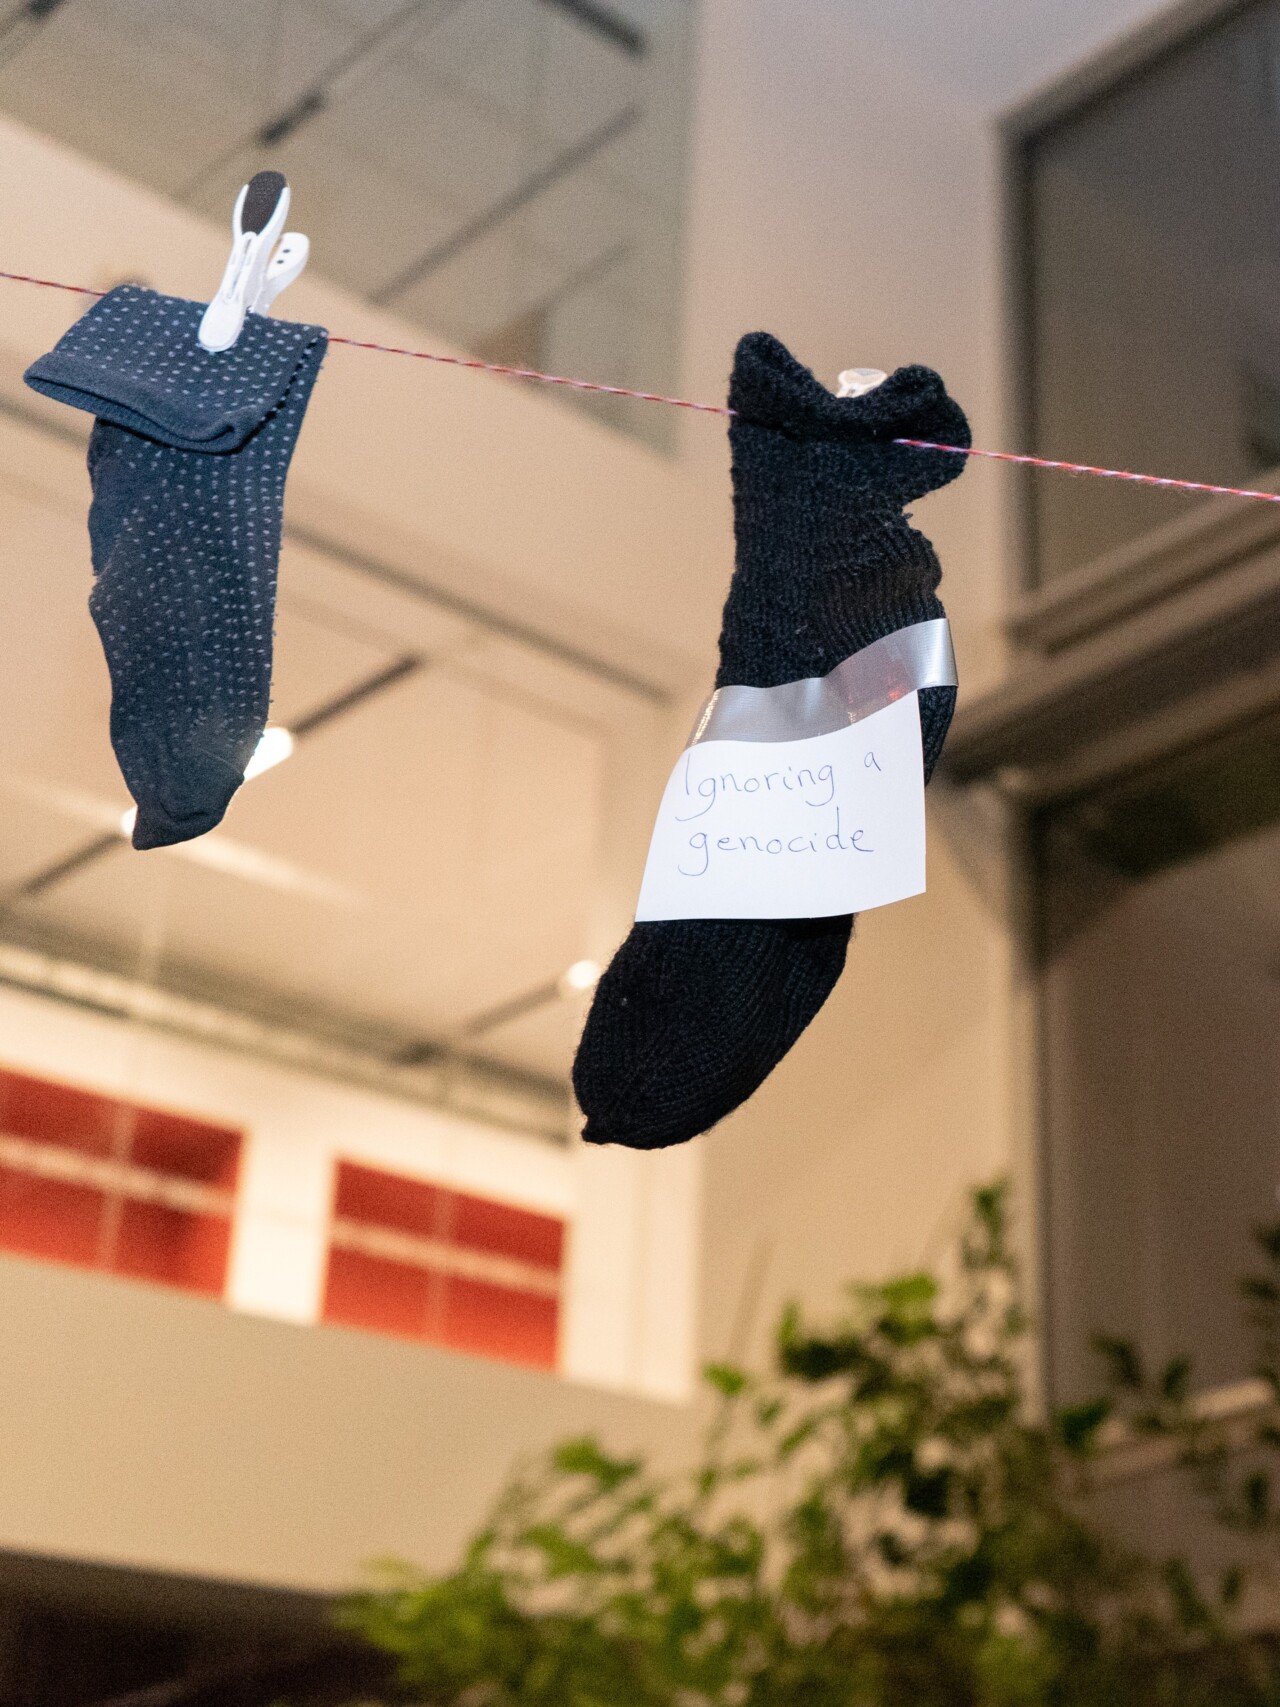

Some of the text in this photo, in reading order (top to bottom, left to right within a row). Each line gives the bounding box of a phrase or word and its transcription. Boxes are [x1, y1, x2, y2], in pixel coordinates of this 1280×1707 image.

[675, 751, 882, 822] Ignoring a
[677, 806, 874, 877] genocide
